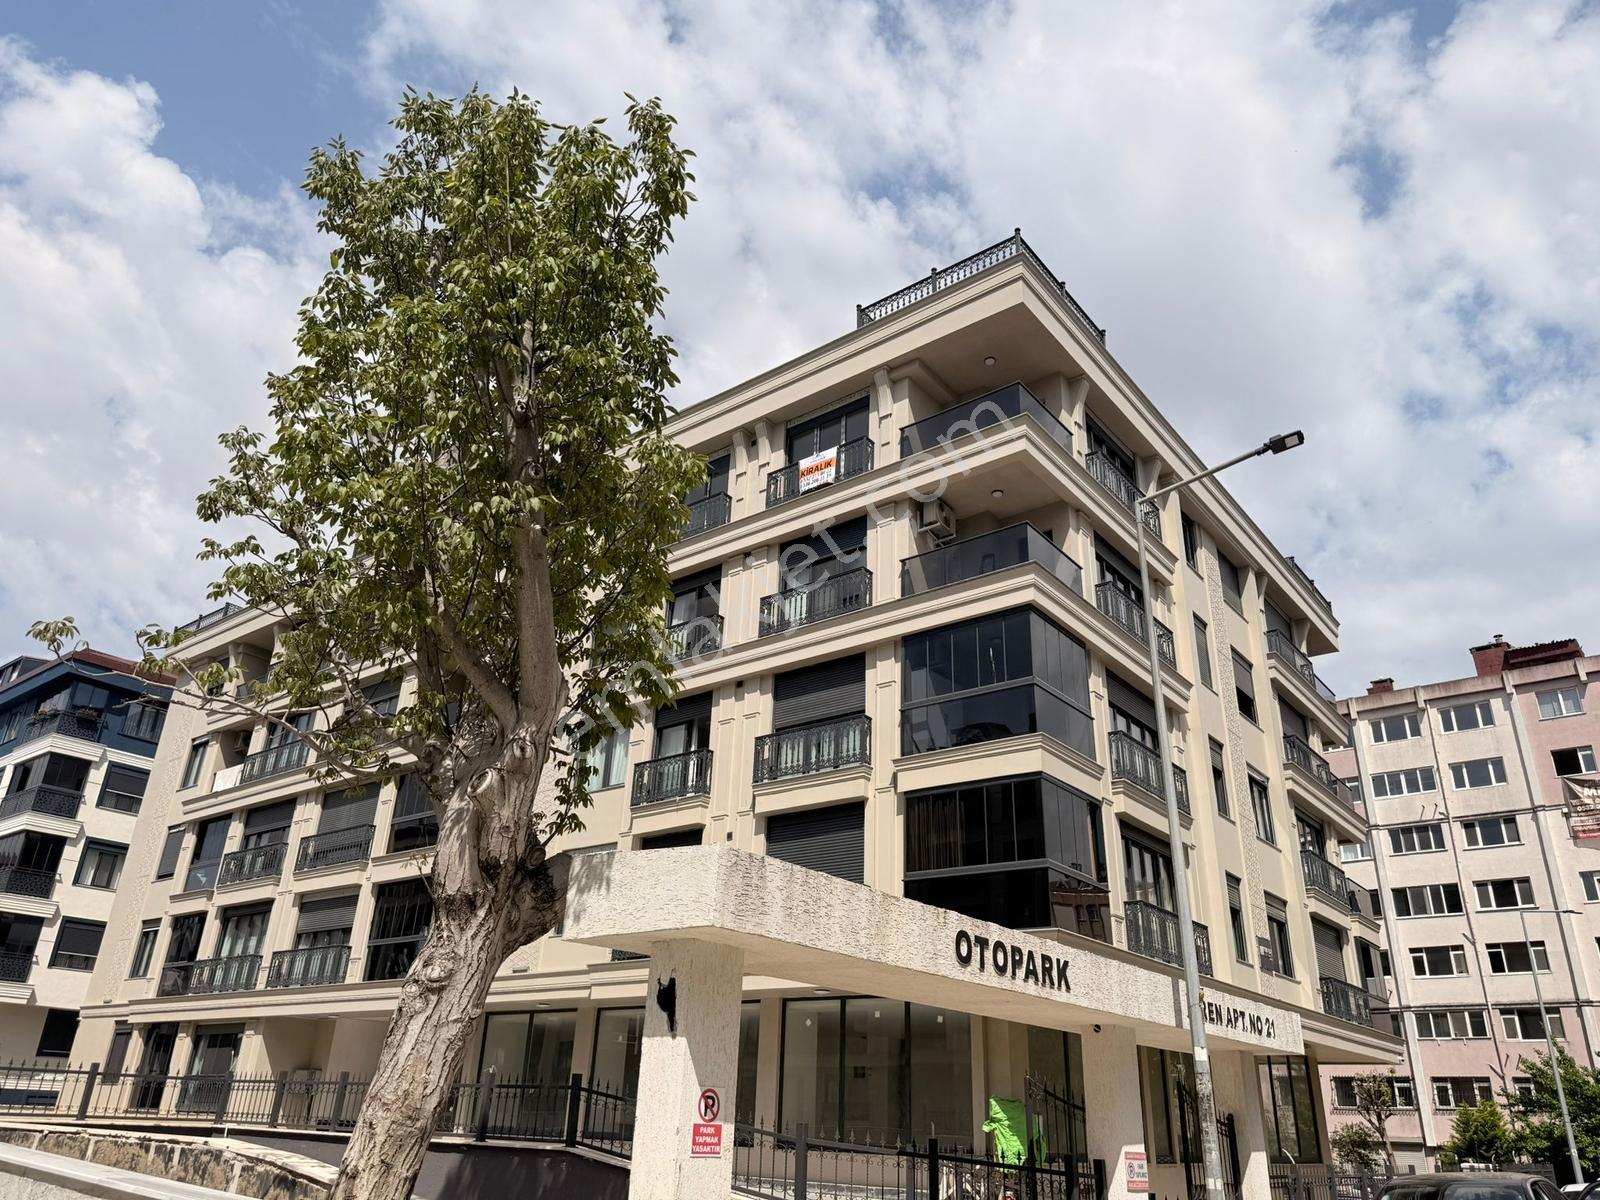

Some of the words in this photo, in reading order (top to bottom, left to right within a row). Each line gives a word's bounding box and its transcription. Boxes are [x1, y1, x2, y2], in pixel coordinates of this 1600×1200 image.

[955, 929, 1071, 993] OTOPARK
[1226, 1006, 1248, 1033] APT.
[1248, 1012, 1263, 1036] NO
[1265, 1016, 1276, 1040] 21
[695, 1135, 719, 1143] YAPMAK
[699, 1126, 716, 1134] PARK
